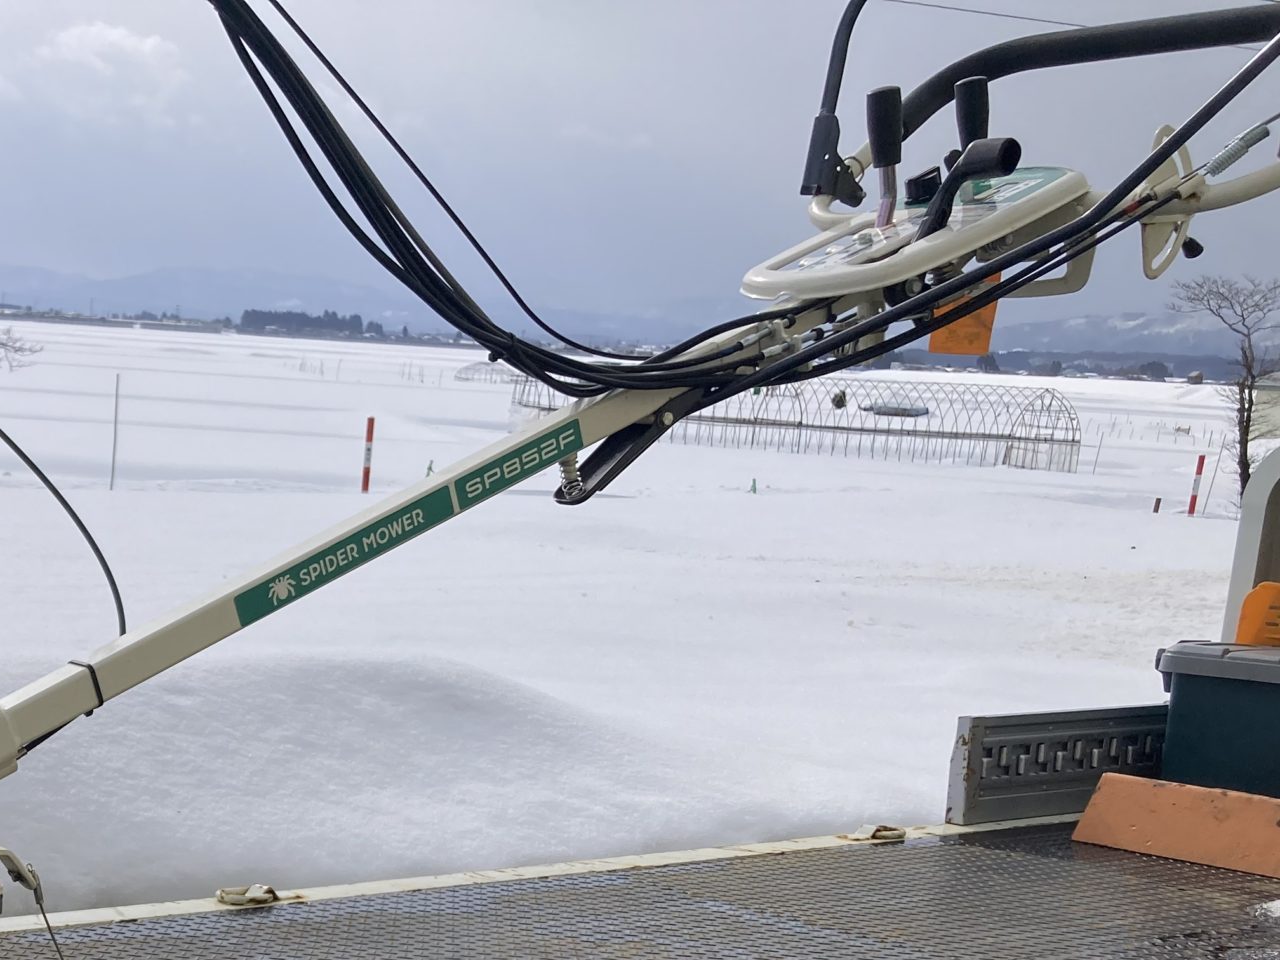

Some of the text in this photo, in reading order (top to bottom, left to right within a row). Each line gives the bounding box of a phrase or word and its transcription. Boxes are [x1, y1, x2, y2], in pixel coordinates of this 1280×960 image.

[465, 428, 576, 499] SP852F
[299, 509, 424, 586] SPIDER MOWER
